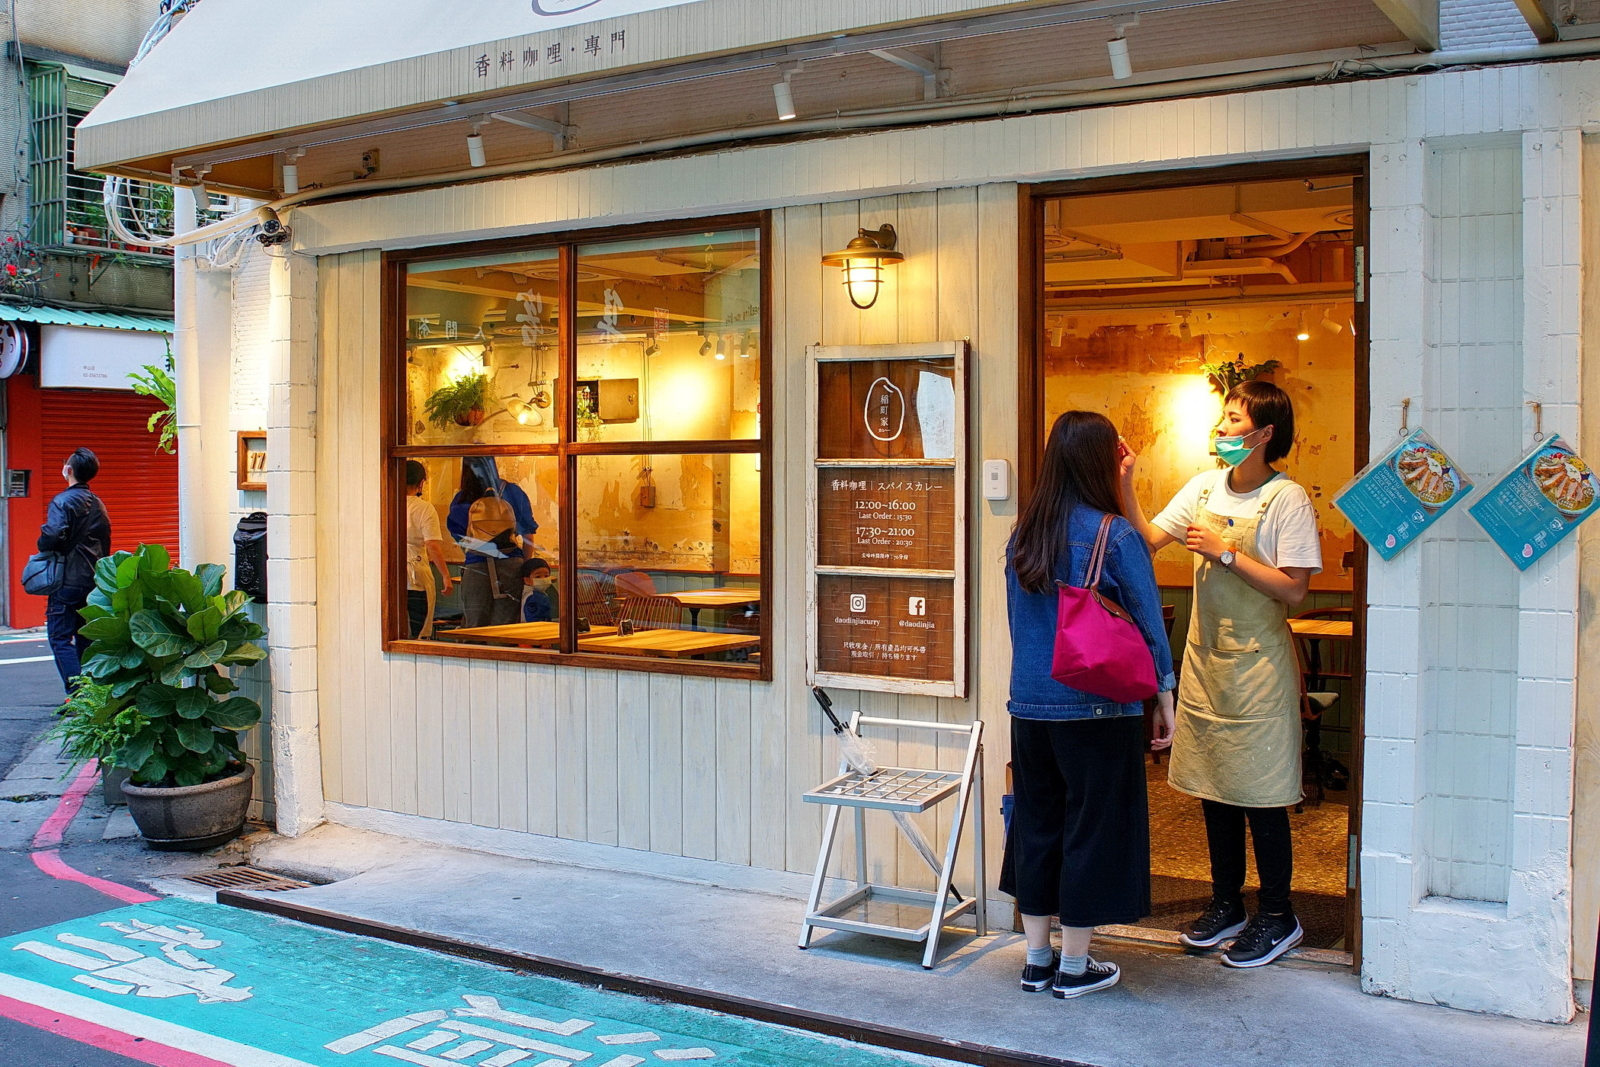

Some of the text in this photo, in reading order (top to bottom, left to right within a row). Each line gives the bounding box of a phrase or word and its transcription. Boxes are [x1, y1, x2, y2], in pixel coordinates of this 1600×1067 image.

[855, 499, 916, 511] 12:00~16:00
[855, 526, 915, 538] 17:30~21:00
[857, 537, 871, 545] Last
